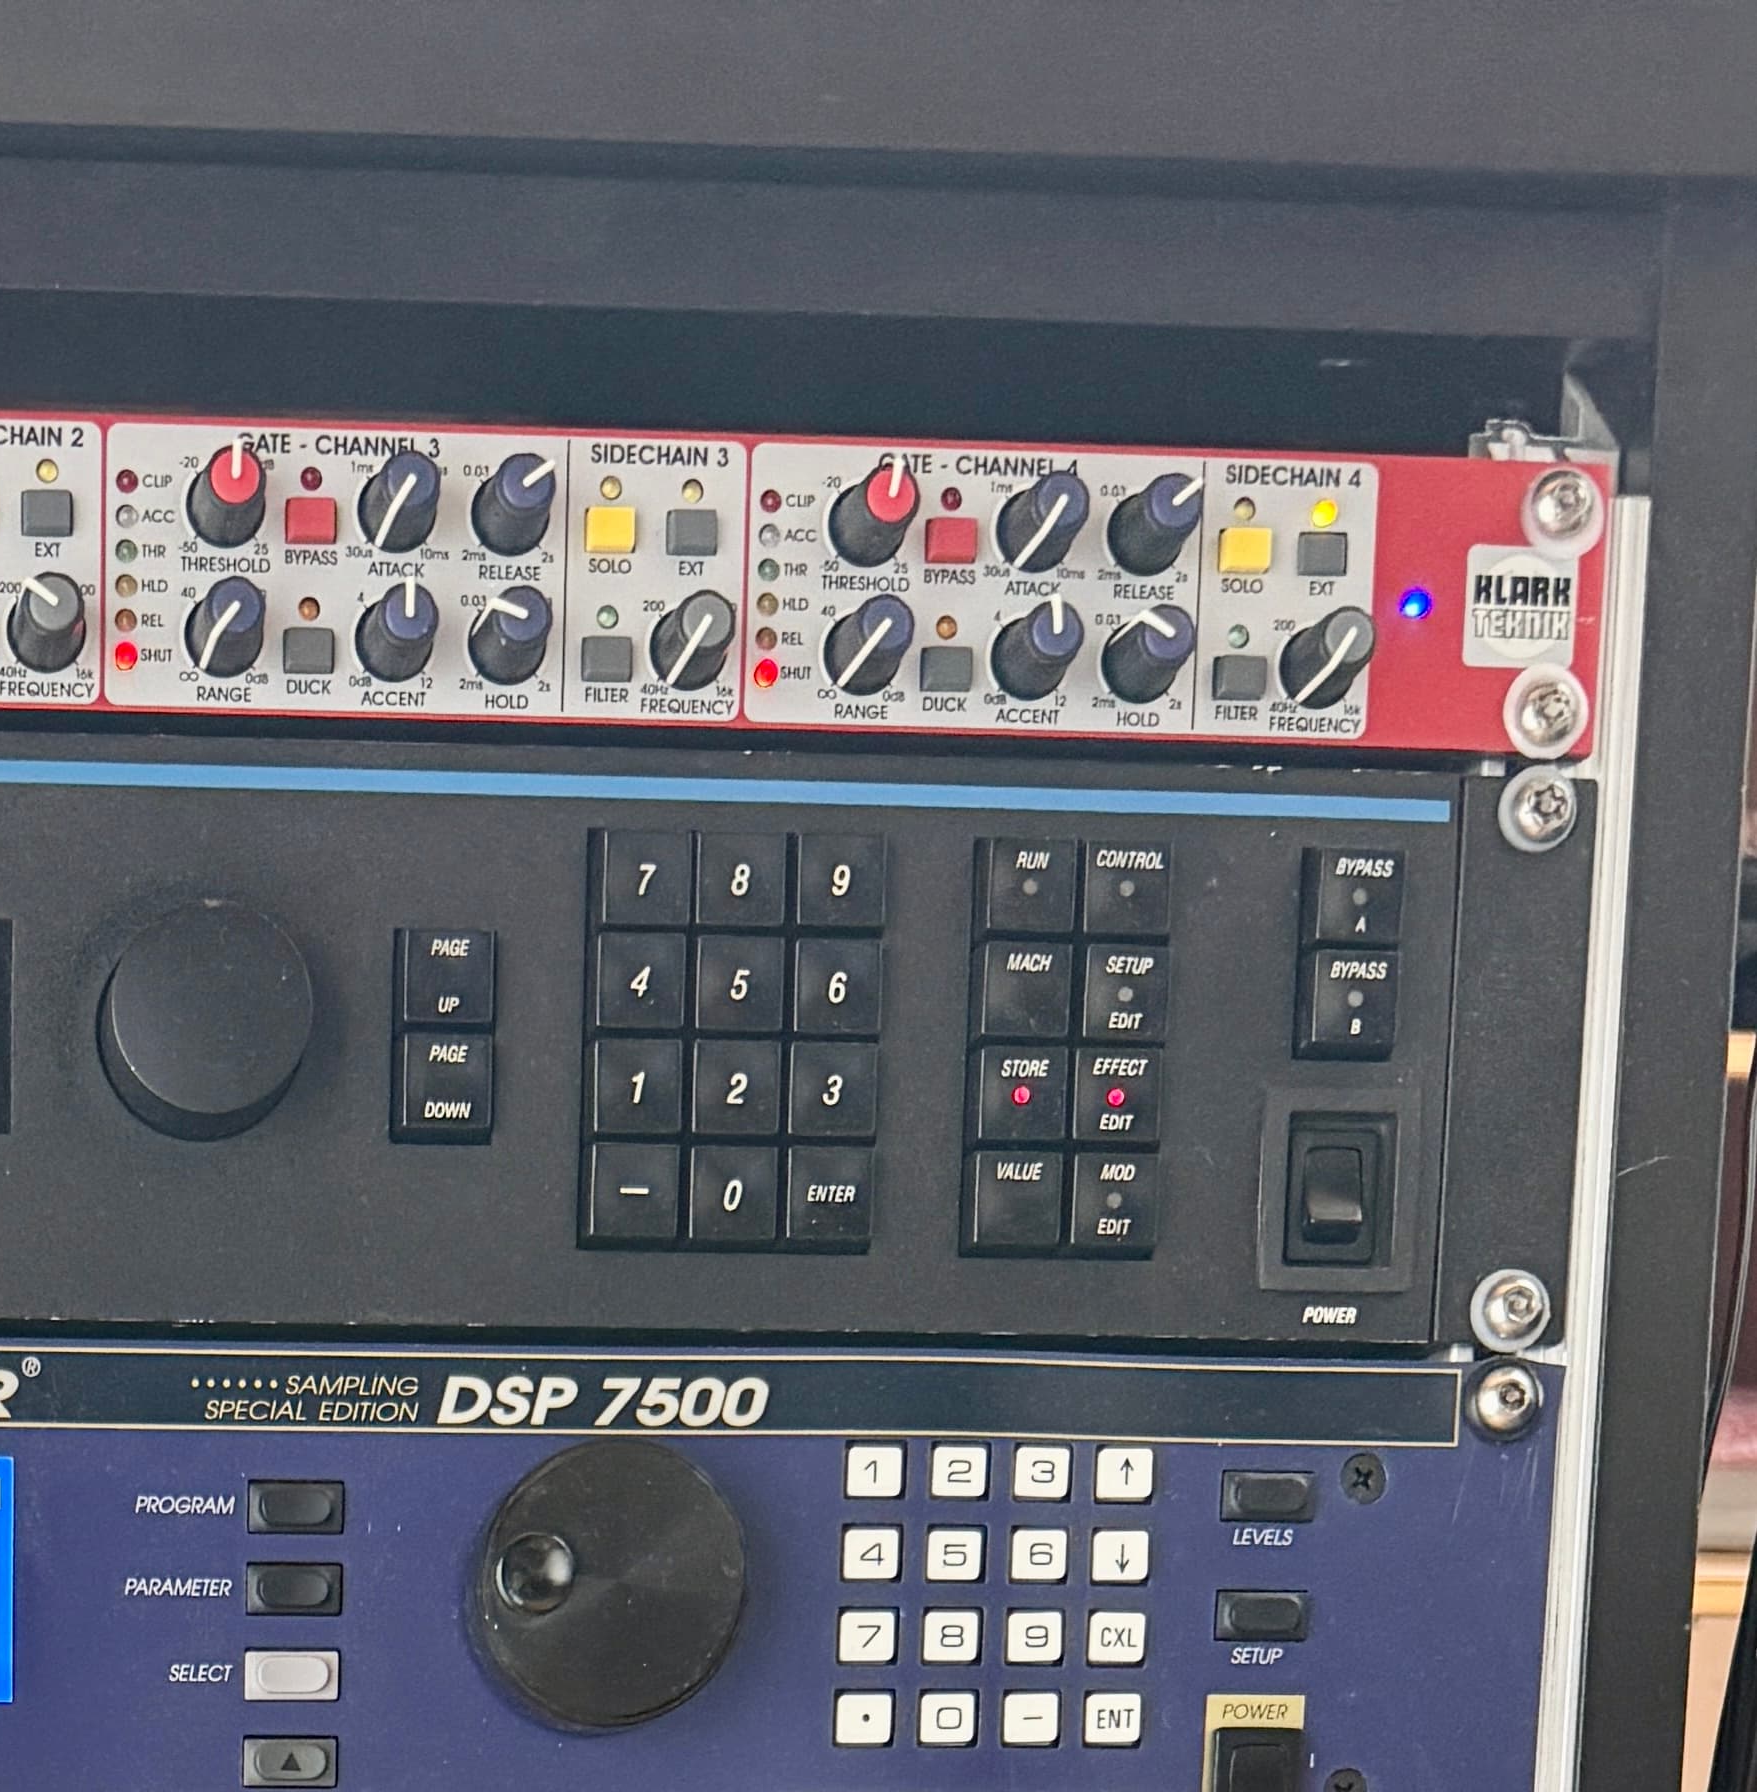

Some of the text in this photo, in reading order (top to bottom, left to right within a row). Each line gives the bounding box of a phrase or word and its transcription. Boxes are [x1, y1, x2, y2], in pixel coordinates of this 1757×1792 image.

[69, 428, 83, 447] 2
[591, 443, 729, 467] SIDECHAIN 3
[1225, 465, 1361, 489] SIDECHAIN 4
[1096, 851, 1163, 869] CONTROL
[807, 1186, 854, 1202] ENTER
[1302, 1308, 1356, 1324] POWER
[285, 1376, 418, 1397] SAMPLING
[437, 1377, 769, 1426] DSP 7500
[204, 1401, 418, 1422] SPECIAL EDITION
[135, 1497, 235, 1515] PROGRAM
[125, 1578, 232, 1597] PARAMETER
